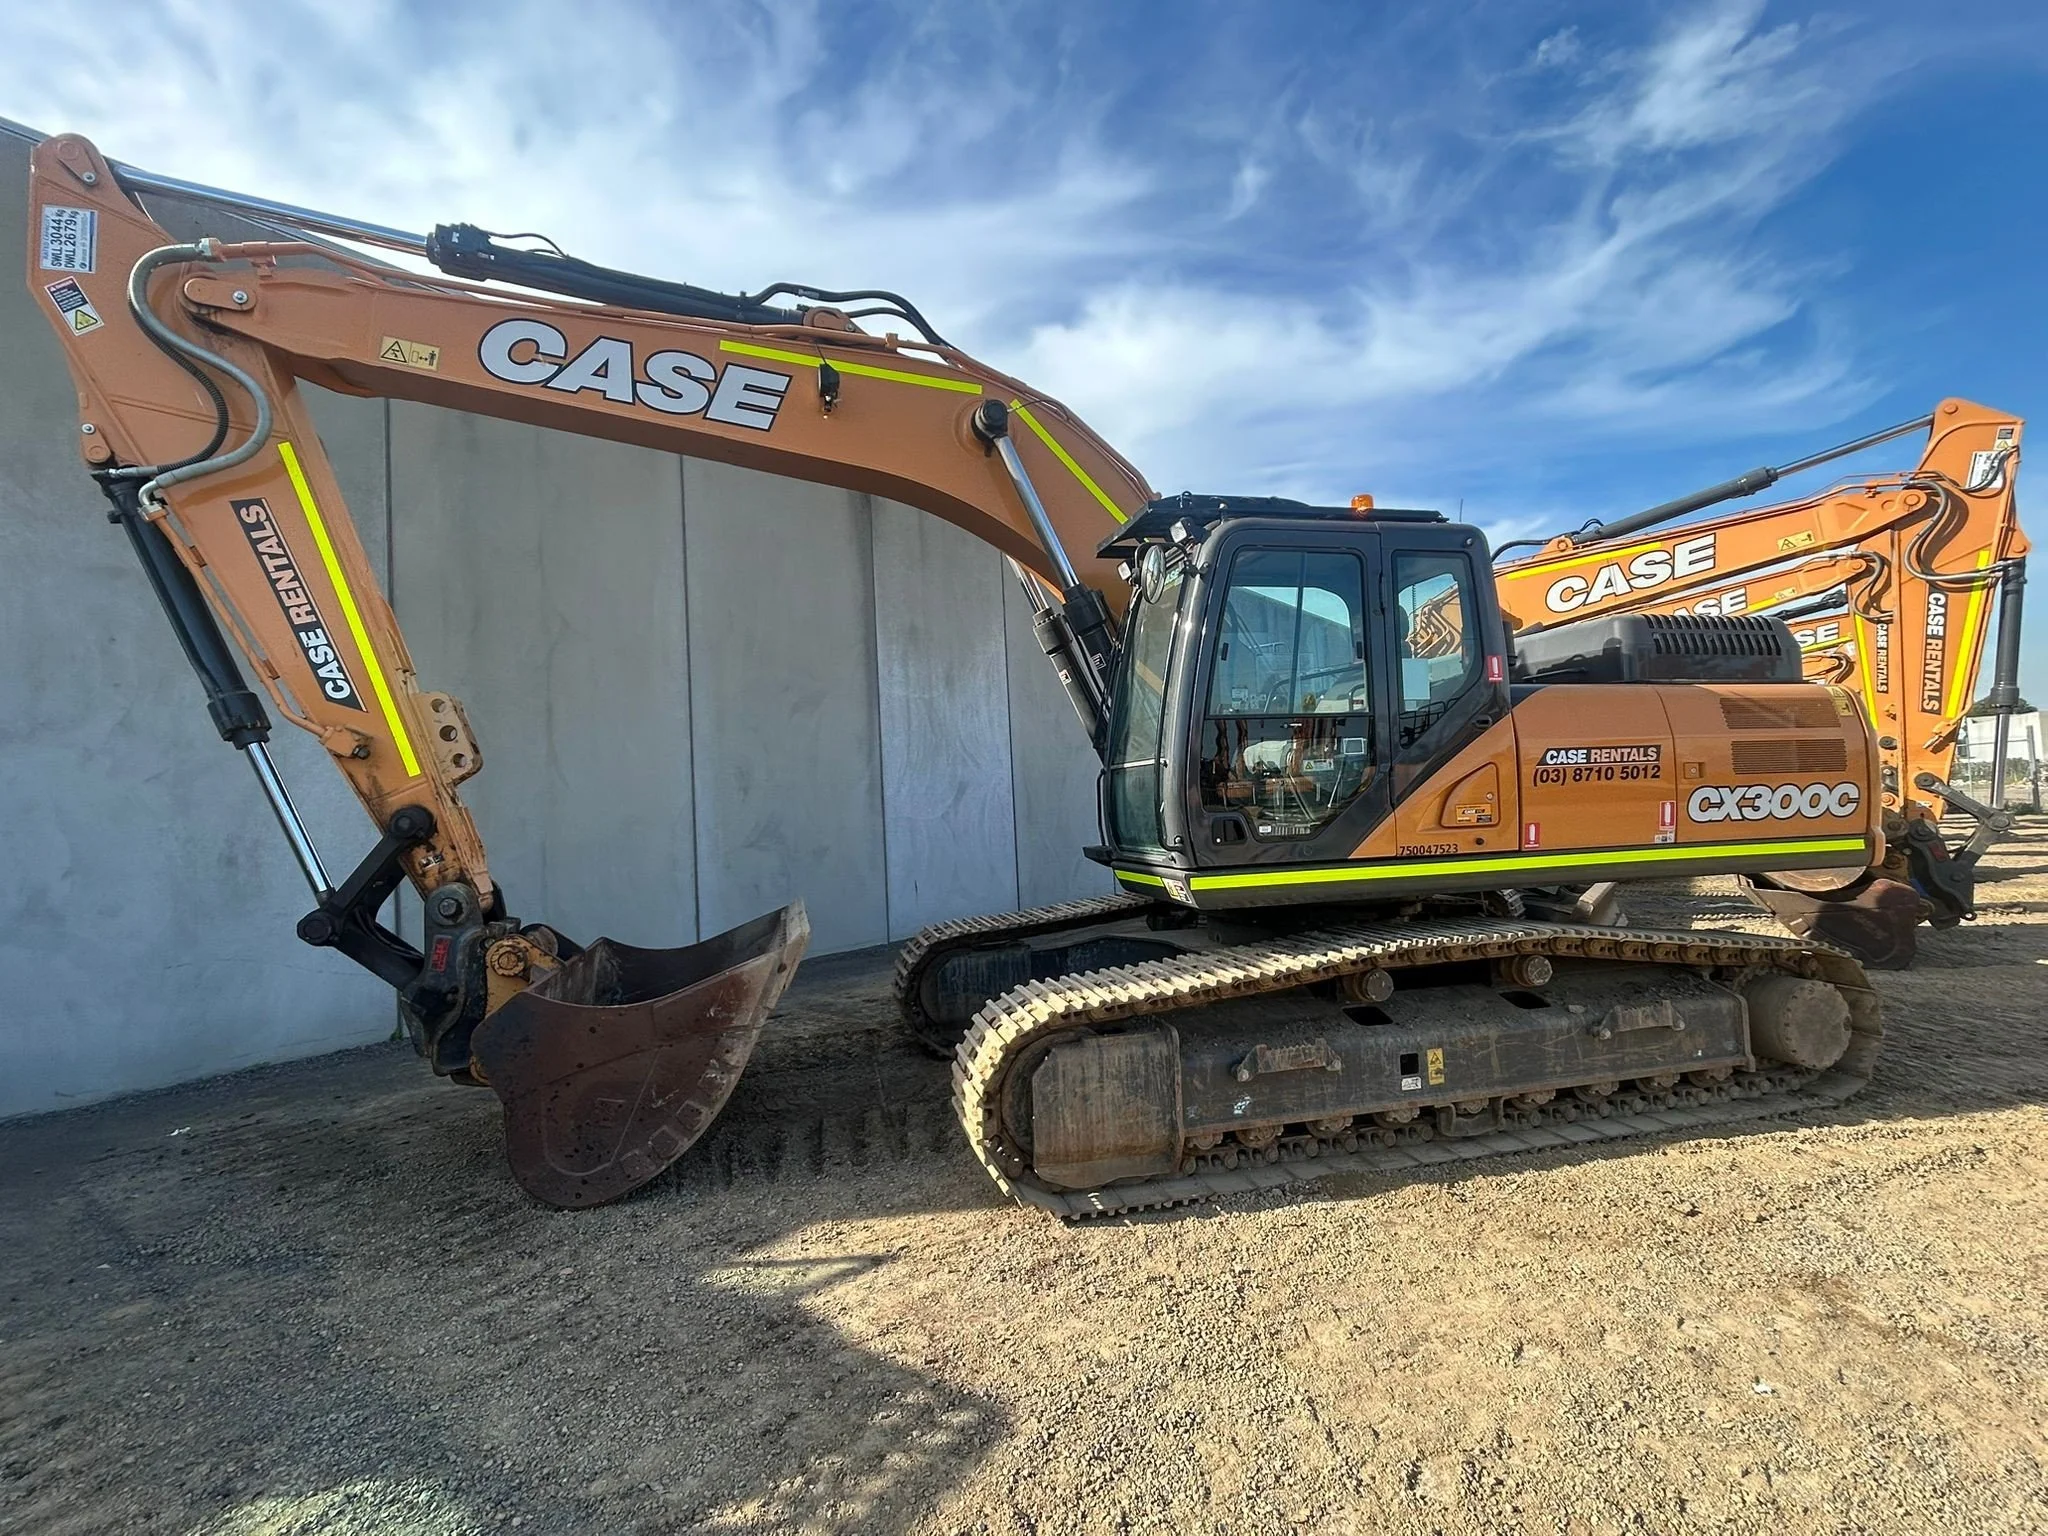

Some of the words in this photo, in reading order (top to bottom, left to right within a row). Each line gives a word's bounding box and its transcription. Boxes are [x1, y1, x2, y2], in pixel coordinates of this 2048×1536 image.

[50, 219, 63, 245] 3044
[64, 219, 77, 247] 2679
[51, 247, 63, 267] SWLL
[64, 248, 76, 268] DWLL
[478, 318, 793, 432] CASE
[239, 503, 318, 626] RENTALS
[1545, 532, 1717, 613] CASE
[1927, 592, 1946, 636] CASE
[1792, 621, 1840, 648] SE
[1876, 622, 1888, 648] CASE
[299, 628, 351, 700] CASE
[1876, 649, 1888, 692] RENTALS
[1922, 638, 1943, 711] RENTALS
[1545, 749, 1587, 764] CASE
[1590, 746, 1658, 762] RENTALS
[1533, 767, 1567, 787] (03)
[1572, 766, 1615, 782] 8710
[1620, 764, 1661, 780] 5012
[1687, 782, 1860, 823] CX300C
[1399, 843, 1459, 856] 750047523
